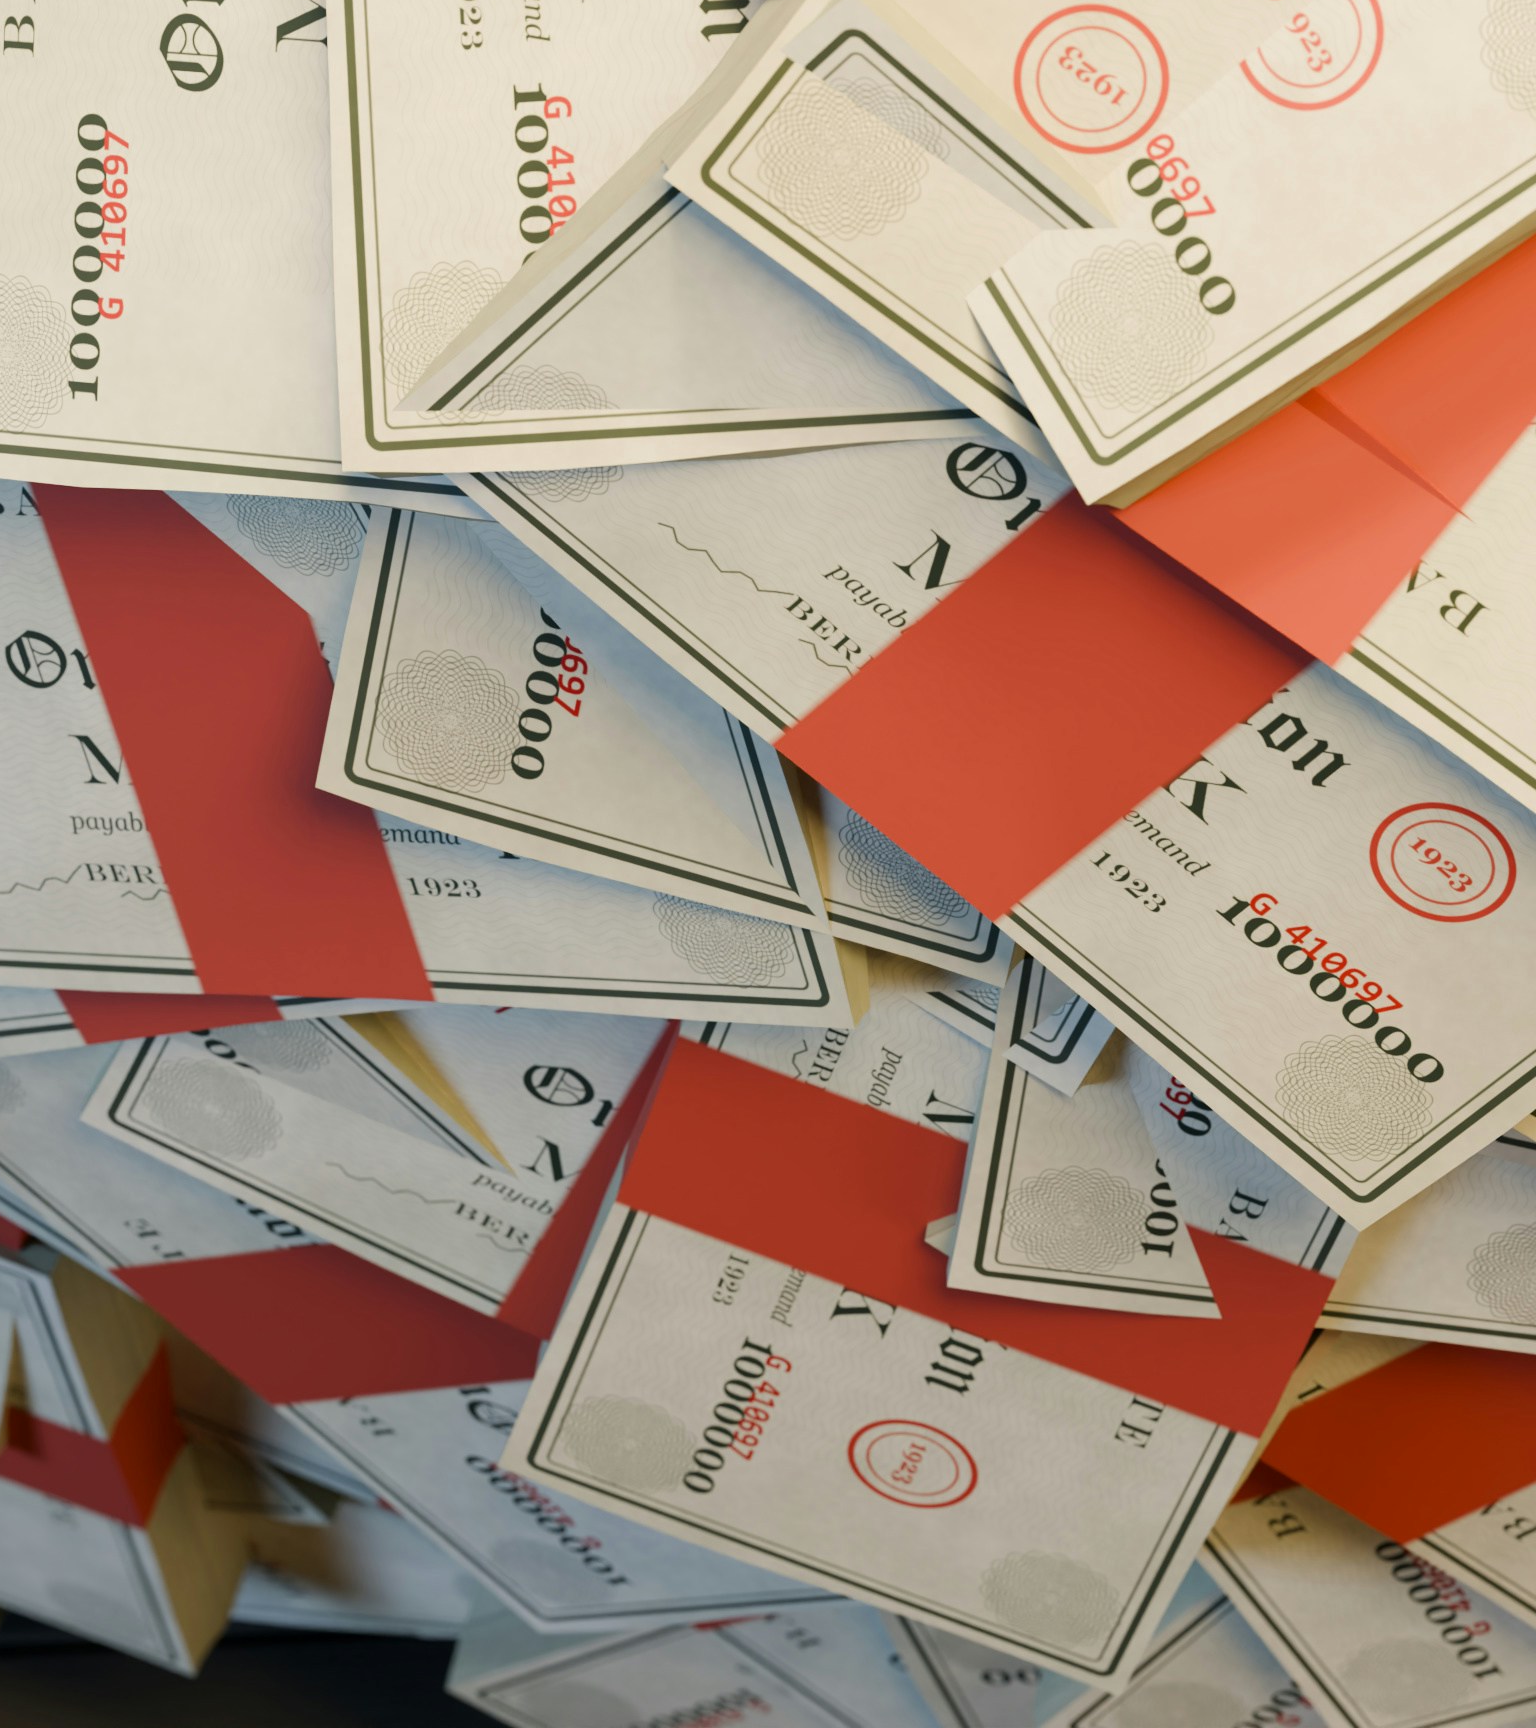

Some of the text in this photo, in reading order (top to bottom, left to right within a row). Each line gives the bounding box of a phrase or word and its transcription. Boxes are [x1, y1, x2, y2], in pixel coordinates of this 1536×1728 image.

[542, 94, 574, 120] G
[1057, 44, 1127, 106] 1923
[512, 82, 555, 246] 1000
[66, 112, 109, 403] 1000000
[96, 129, 130, 321] G 410697
[407, 876, 483, 899] 1923
[1092, 851, 1168, 914] 1923
[1410, 838, 1478, 904] 1923
[1215, 895, 1446, 1084] 1000000
[1248, 892, 1404, 1015] G 410697
[712, 1253, 751, 1307] 1923
[682, 1337, 774, 1495] 1000000
[729, 1353, 794, 1462] G 410697
[891, 1442, 927, 1486] 1923
